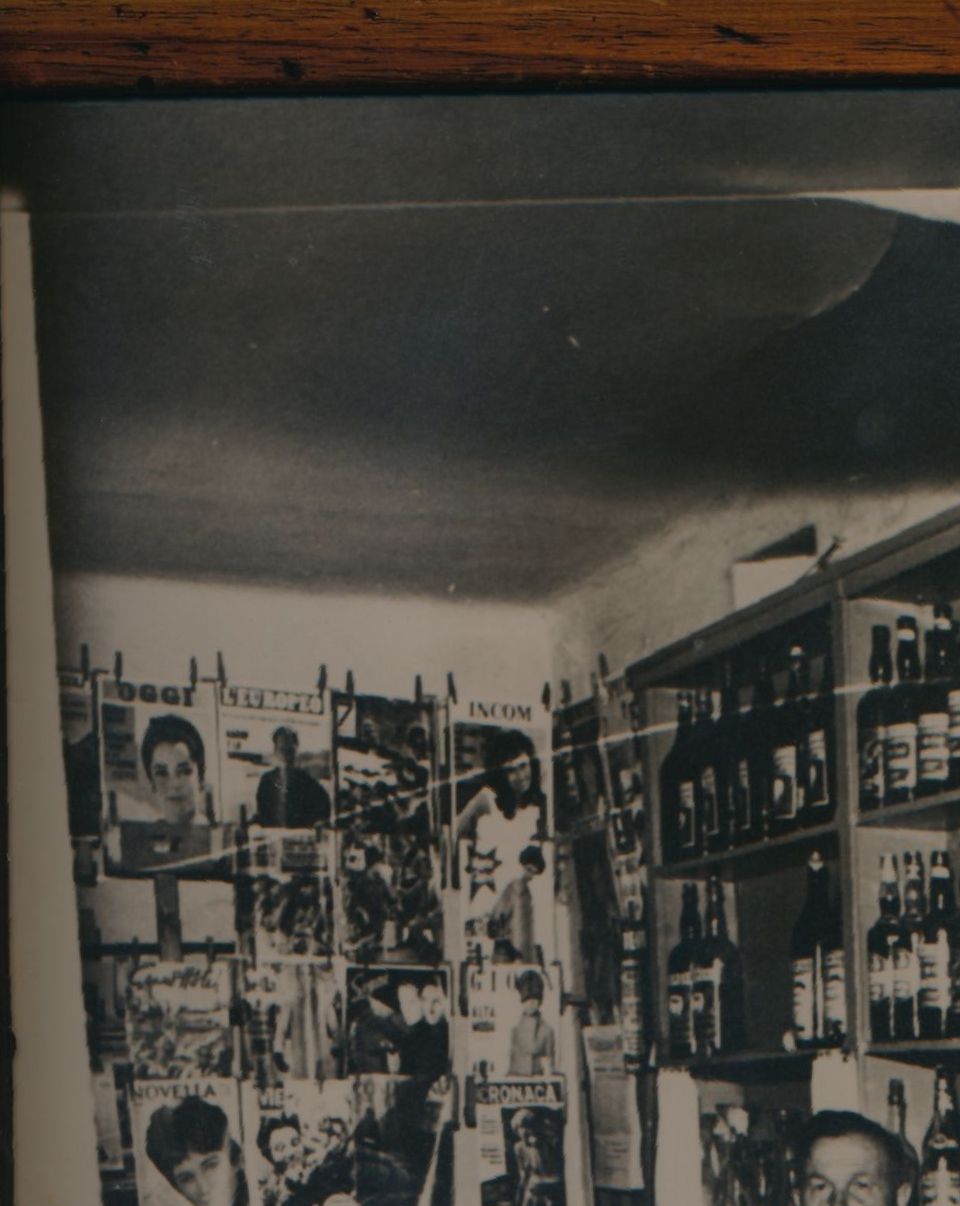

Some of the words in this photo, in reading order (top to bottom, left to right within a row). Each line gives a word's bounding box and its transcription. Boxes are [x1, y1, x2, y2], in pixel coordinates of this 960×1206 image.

[117, 681, 193, 708] OGGI
[469, 701, 532, 722] INCOM
[132, 1082, 217, 1105] NOVELLA
[477, 1083, 557, 1105] CRONACA
